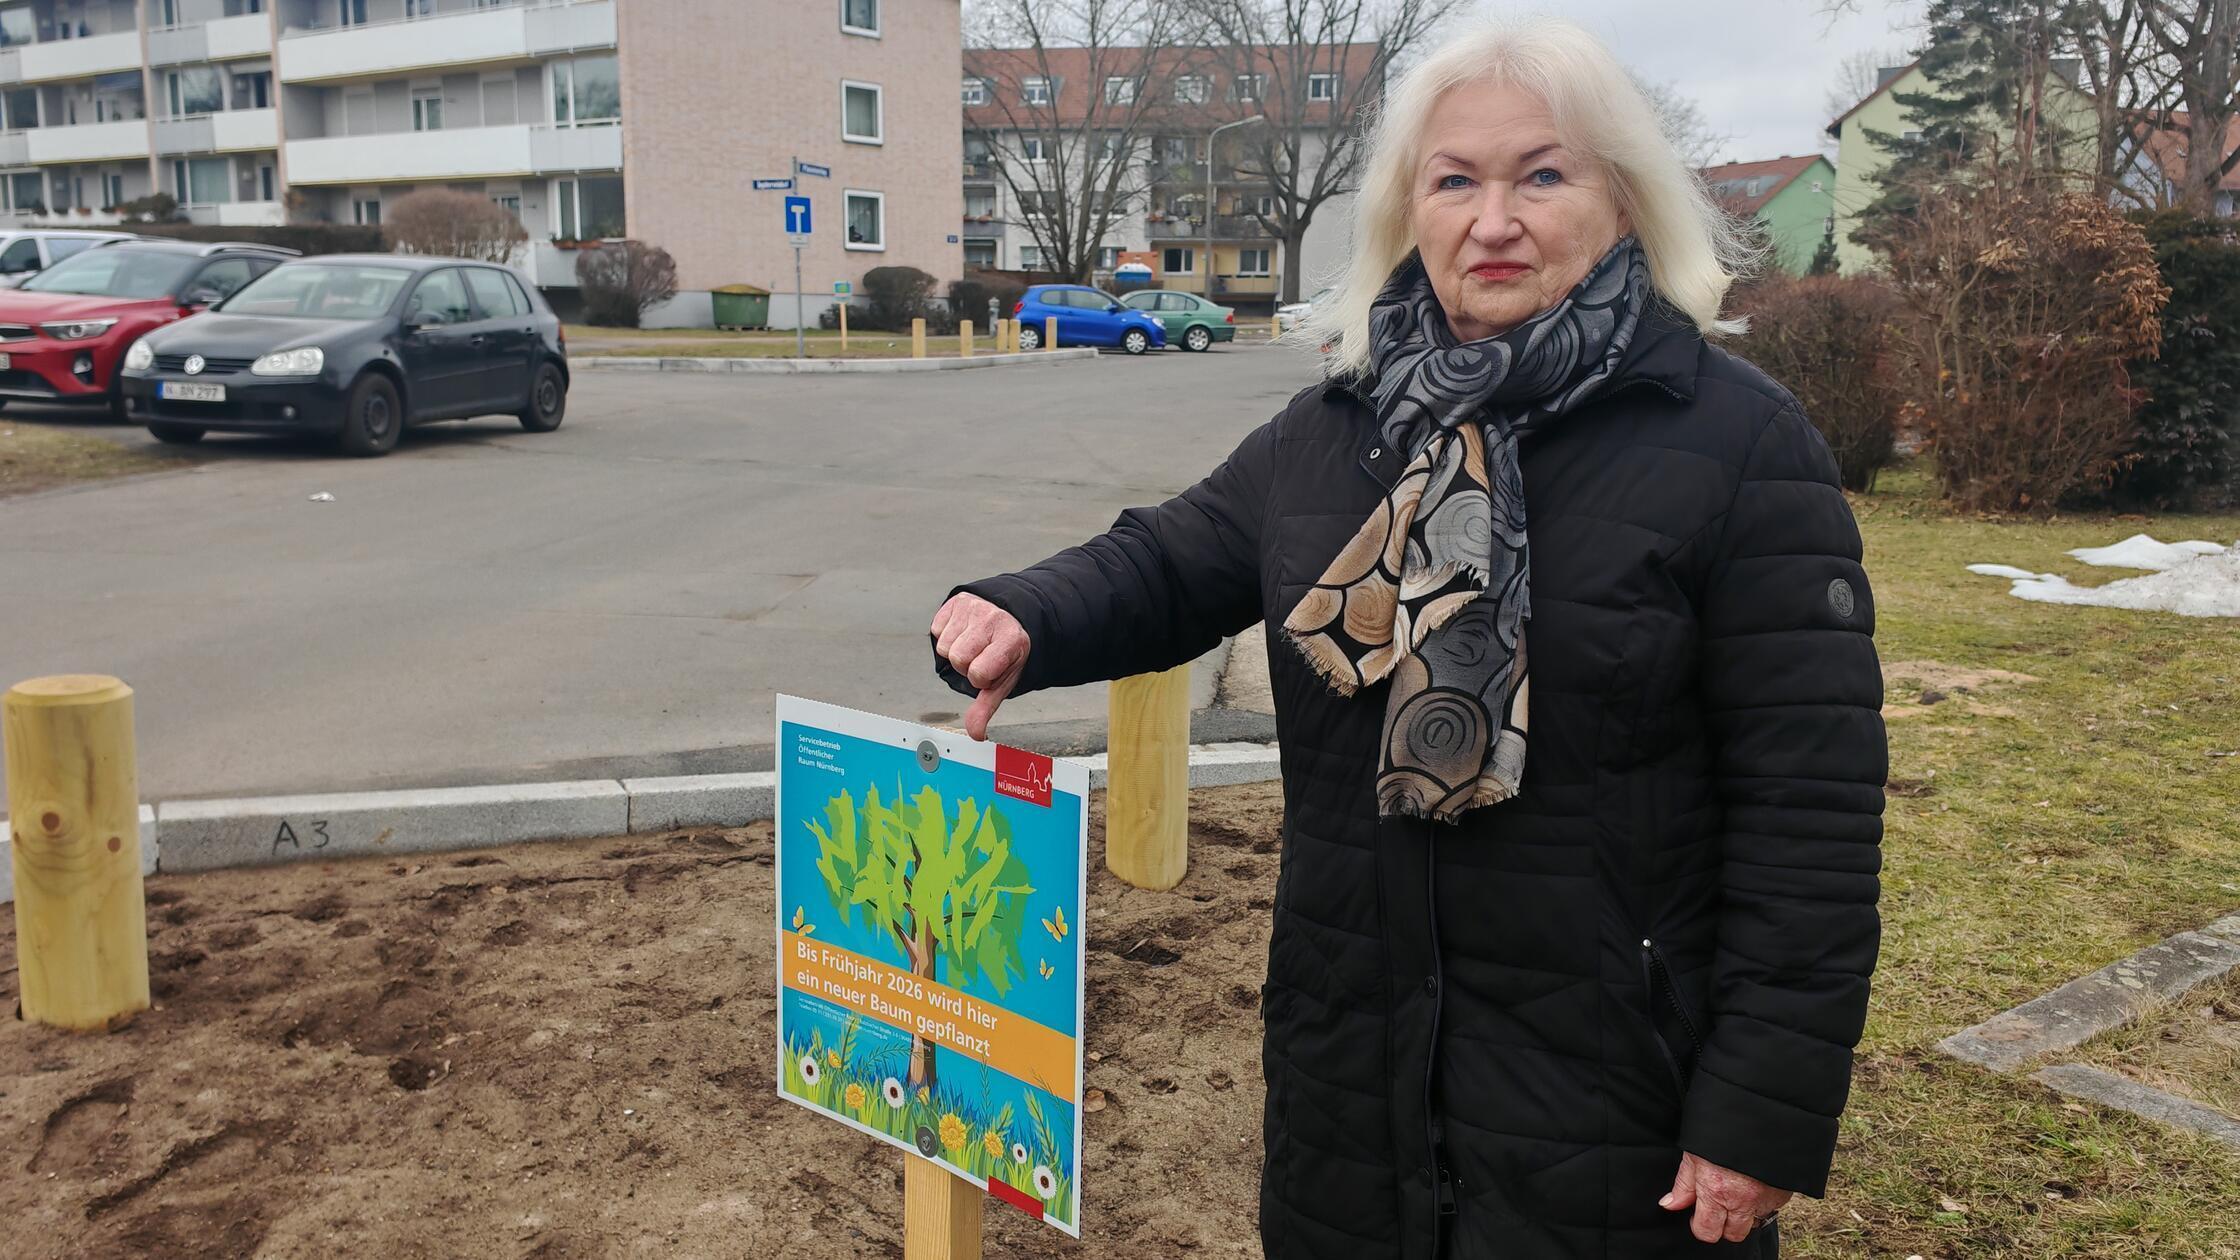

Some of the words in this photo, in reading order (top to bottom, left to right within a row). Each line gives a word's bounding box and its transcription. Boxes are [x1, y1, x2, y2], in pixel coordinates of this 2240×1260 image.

[798, 734, 841, 751] Servicebetrieb
[798, 744, 834, 760] Öffentlicher
[798, 756, 816, 767] Raum
[816, 760, 845, 776] Nürnberg
[997, 780, 1035, 799] NÜRNBERG
[797, 941, 818, 963] Bis
[822, 949, 883, 986] Frühjahr
[887, 973, 923, 1001] 2026
[927, 990, 962, 1017] wird
[967, 1002, 998, 1030] hier
[797, 970, 819, 990] ein
[824, 978, 866, 1006] neuer
[870, 993, 912, 1024] Baum
[916, 1015, 991, 1057] gepflanzt
